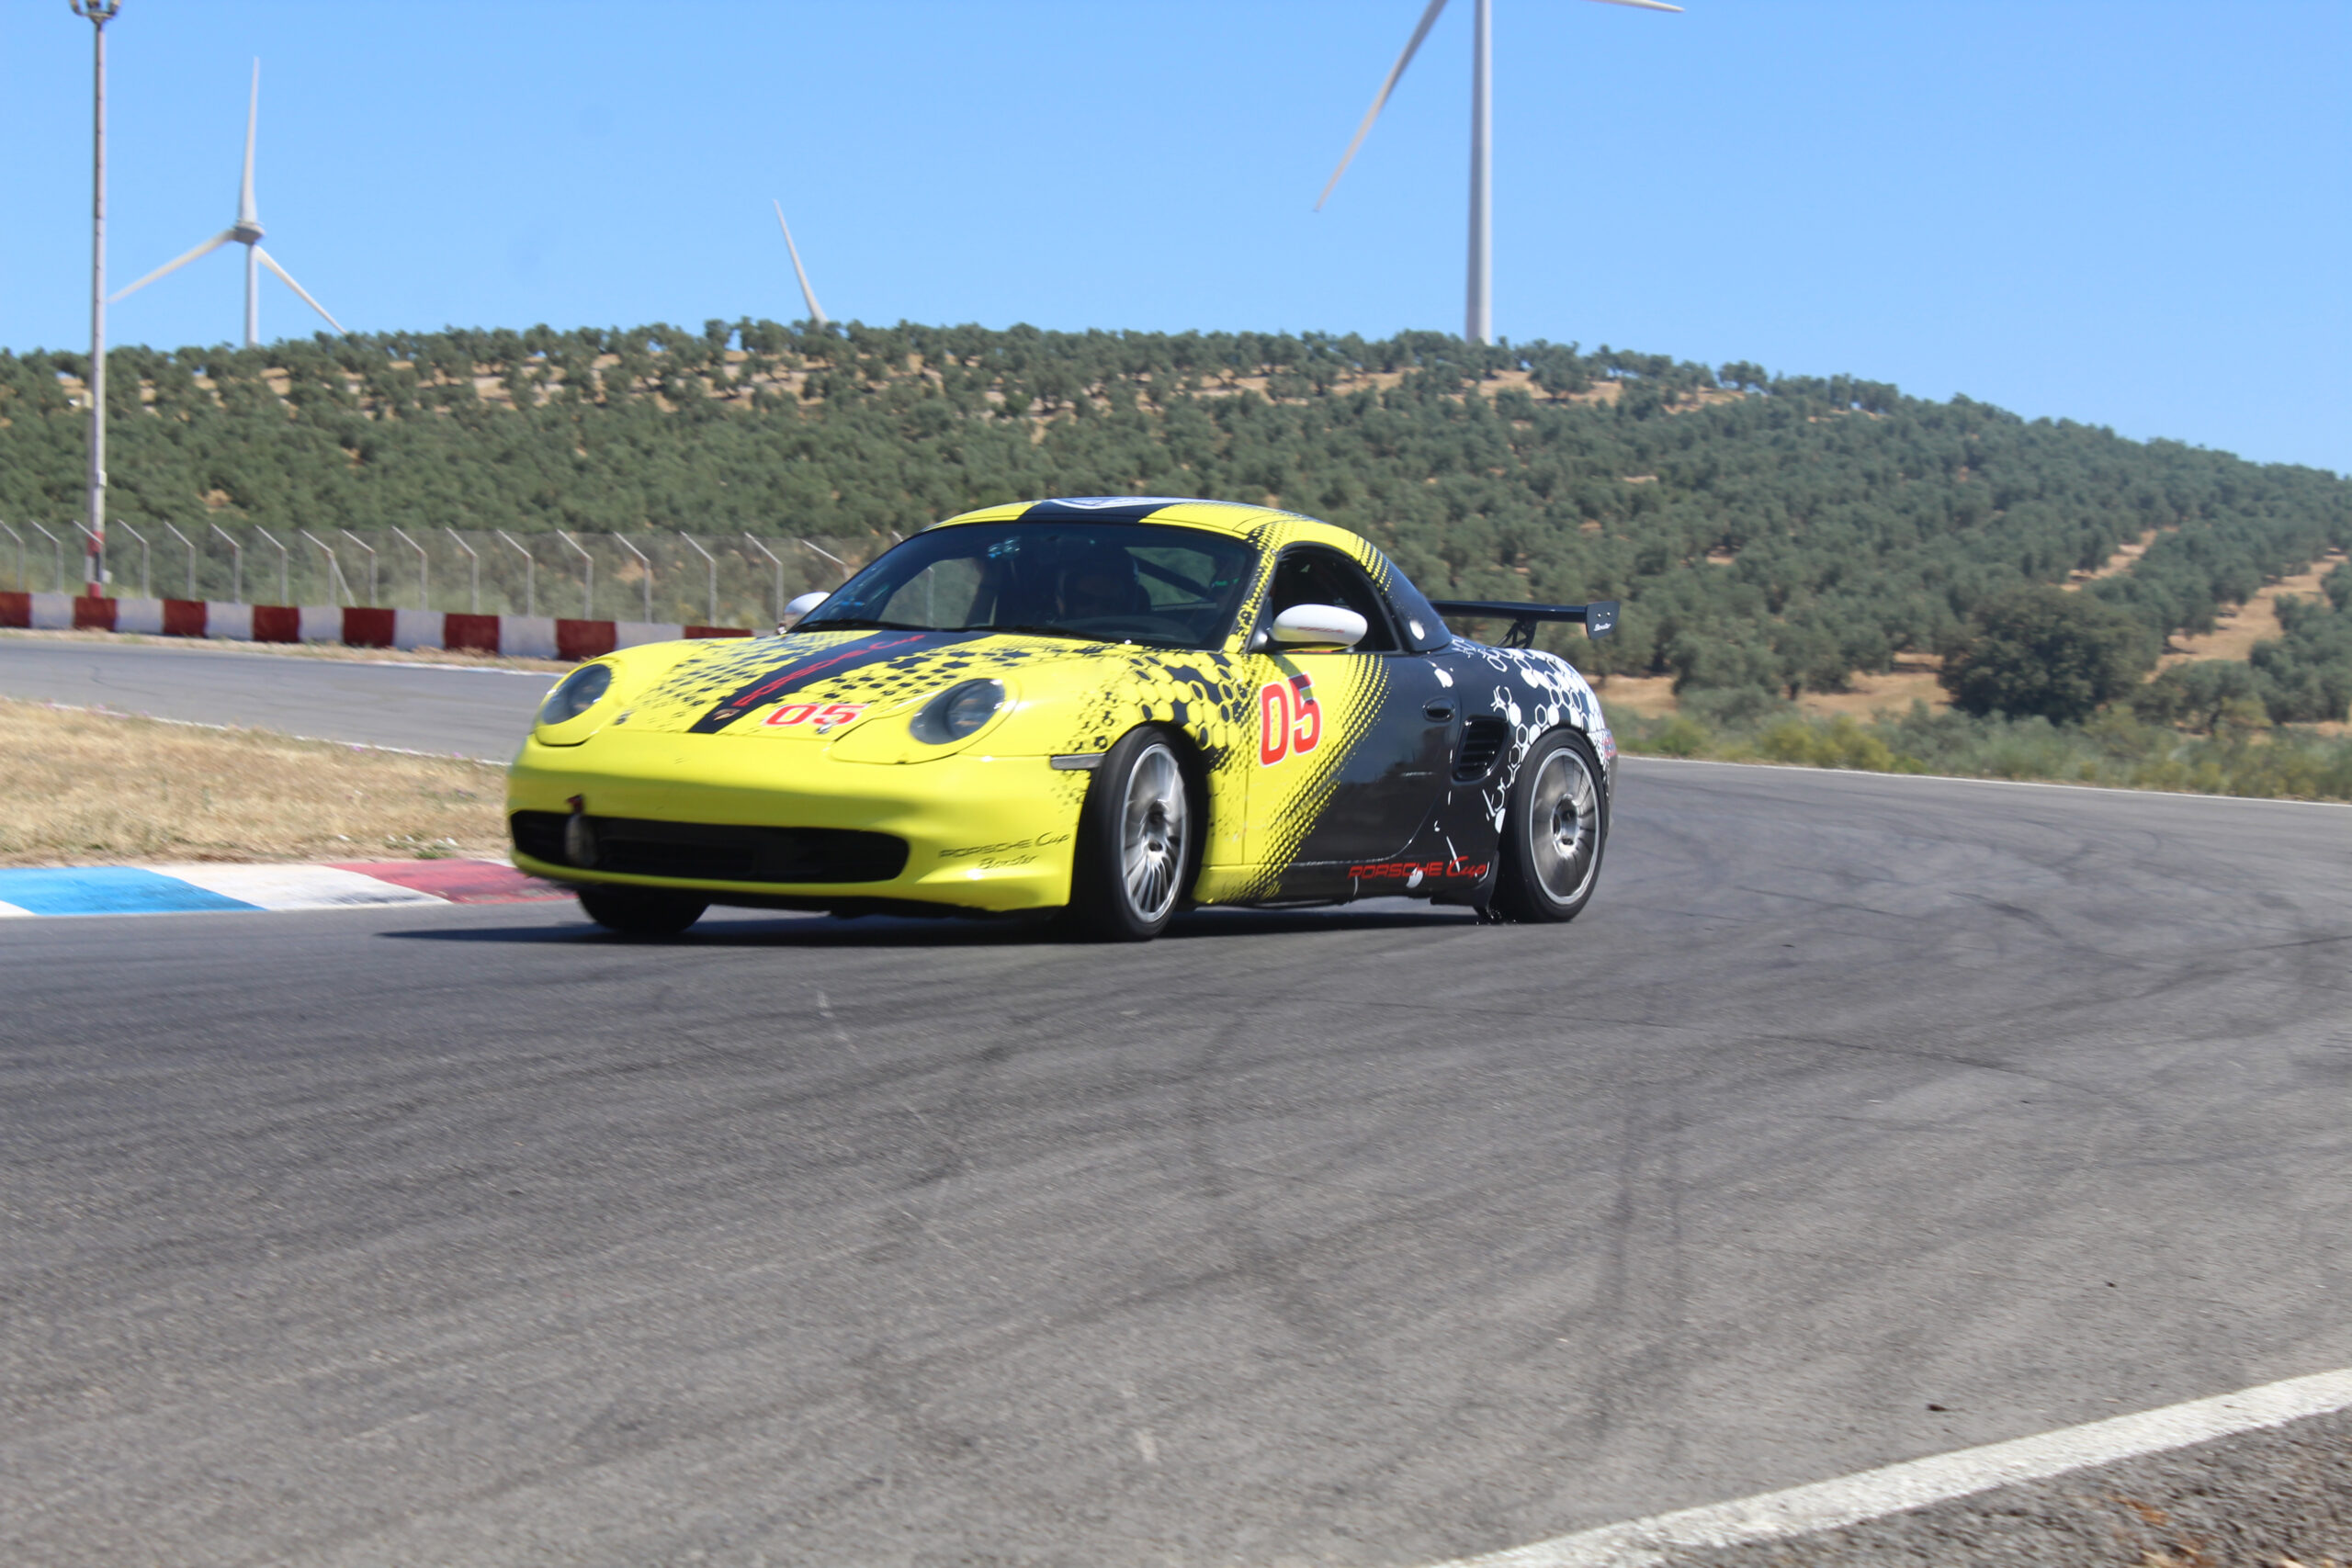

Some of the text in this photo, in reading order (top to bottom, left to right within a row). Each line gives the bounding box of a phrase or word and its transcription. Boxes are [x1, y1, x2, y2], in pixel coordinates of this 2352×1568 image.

[763, 703, 869, 727] 05
[1260, 672, 1321, 767] 05
[1035, 831, 1070, 847] Cup
[1347, 855, 1488, 879] PORSCHE Cup
